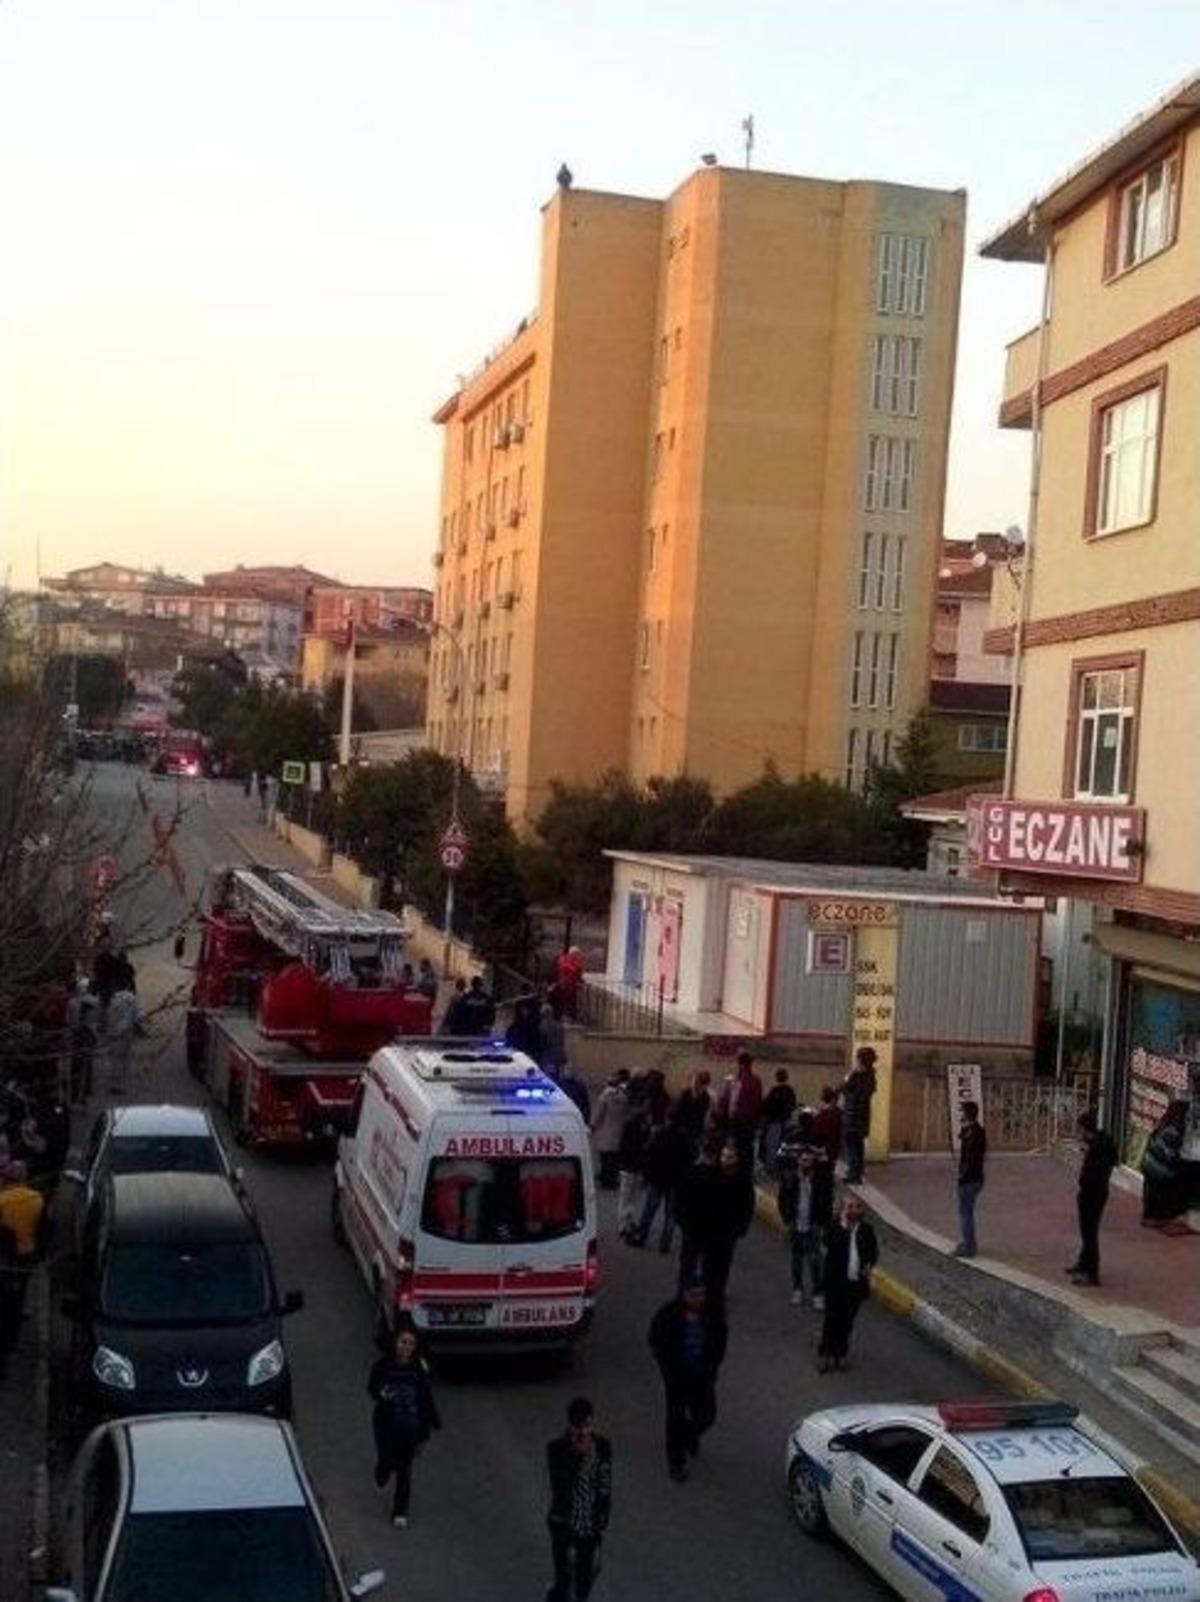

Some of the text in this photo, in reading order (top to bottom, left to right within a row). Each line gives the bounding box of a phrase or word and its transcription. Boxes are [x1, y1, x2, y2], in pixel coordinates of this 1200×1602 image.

[1009, 810, 1132, 869] ECZANE
[820, 937, 842, 965] E
[446, 1135, 566, 1155] AMBULANS
[502, 1305, 576, 1323] AMBULANS
[975, 1437, 1026, 1461] 95
